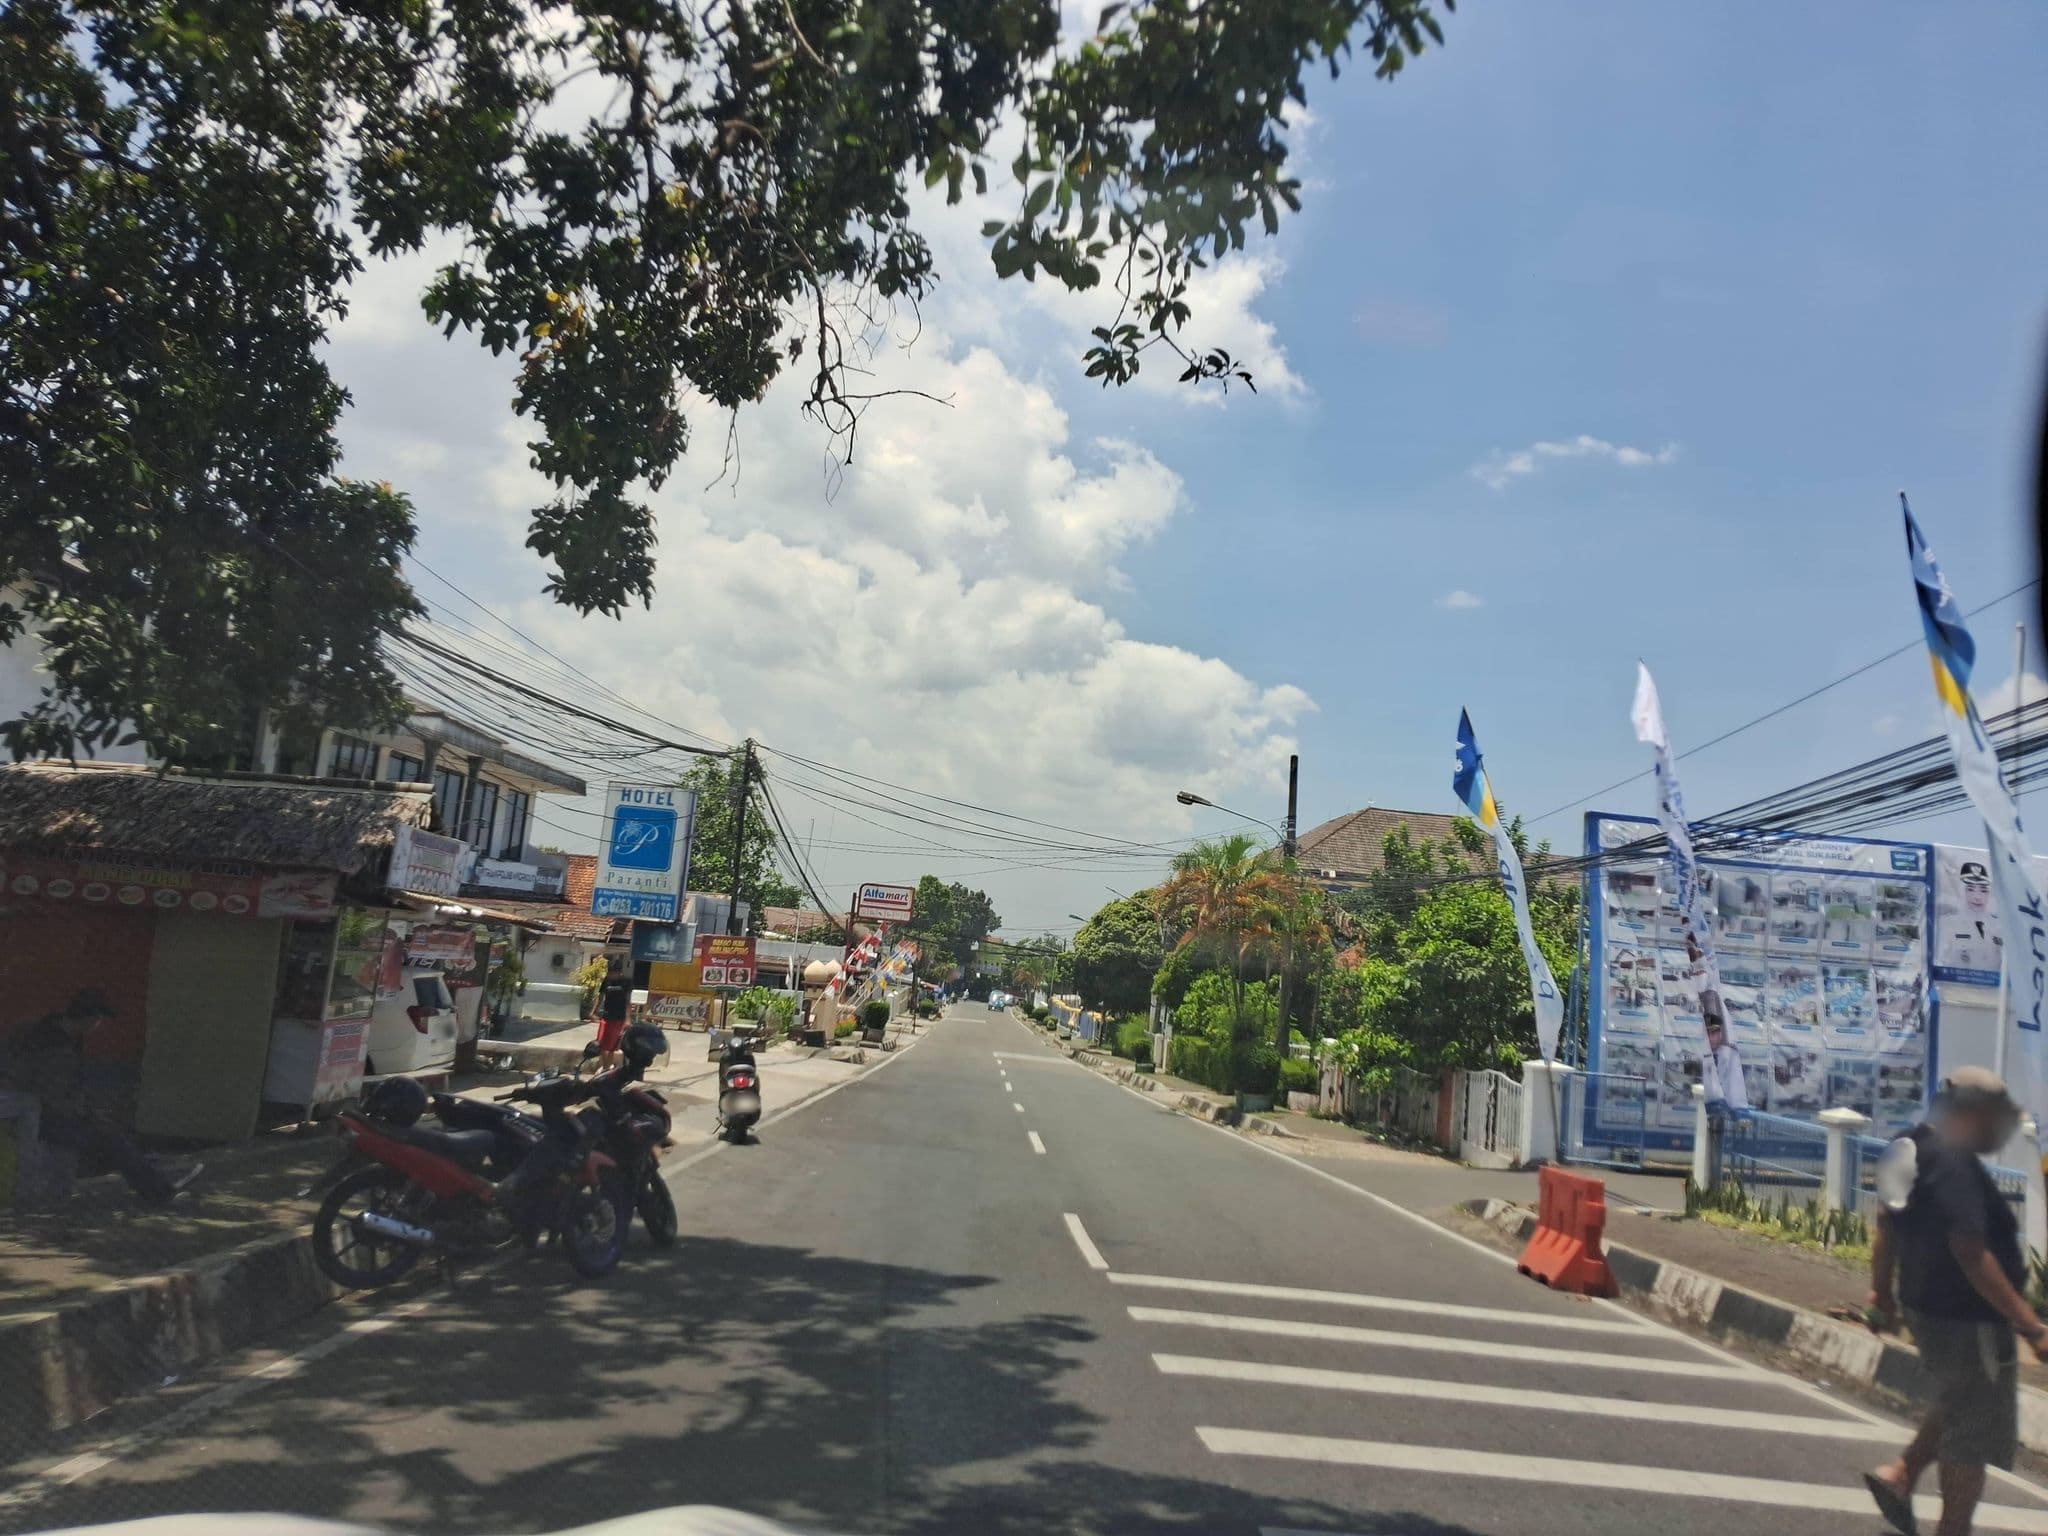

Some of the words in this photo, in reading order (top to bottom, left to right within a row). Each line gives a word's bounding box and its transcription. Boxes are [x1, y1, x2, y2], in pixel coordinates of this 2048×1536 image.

[621, 787, 675, 806] HOTEL
[607, 871, 668, 888] Paranti
[864, 888, 909, 901] Alfamart
[609, 897, 632, 914] 0253
[640, 900, 672, 918] 201176
[651, 1001, 686, 1016] COFFEE
